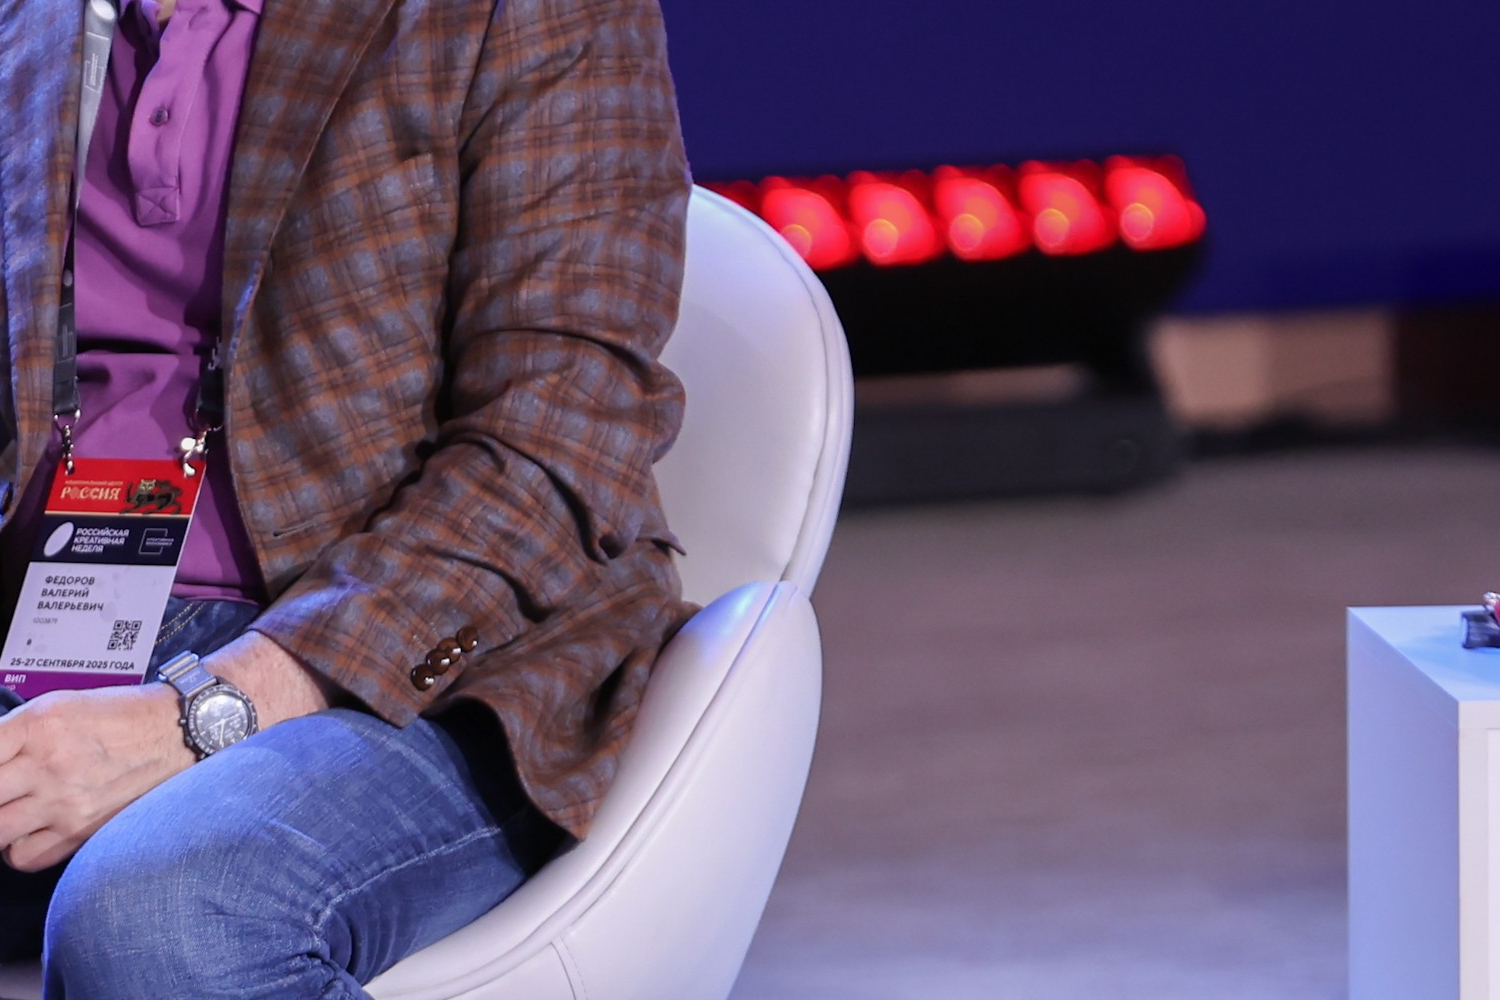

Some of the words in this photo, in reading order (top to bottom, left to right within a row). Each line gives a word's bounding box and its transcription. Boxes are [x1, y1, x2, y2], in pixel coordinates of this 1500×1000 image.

[60, 486, 121, 500] РОССИЯ
[75, 527, 130, 537] РОССИЙСКАЯ
[73, 536, 126, 545] КРЕАТИВНАЯ
[71, 544, 104, 553] НЕДЕЛЯ
[45, 575, 95, 585] ФЕДОРОВ
[41, 587, 90, 598] ВАЛЕРИЙ
[37, 601, 104, 611] ВАЛЕРЬЕВИЧ
[10, 658, 35, 666] 25-27
[36, 658, 85, 668] СЕНТЯБРЯ
[86, 660, 108, 669] 2025
[109, 661, 135, 670] ГОДА
[4, 673, 26, 683] ВИП
